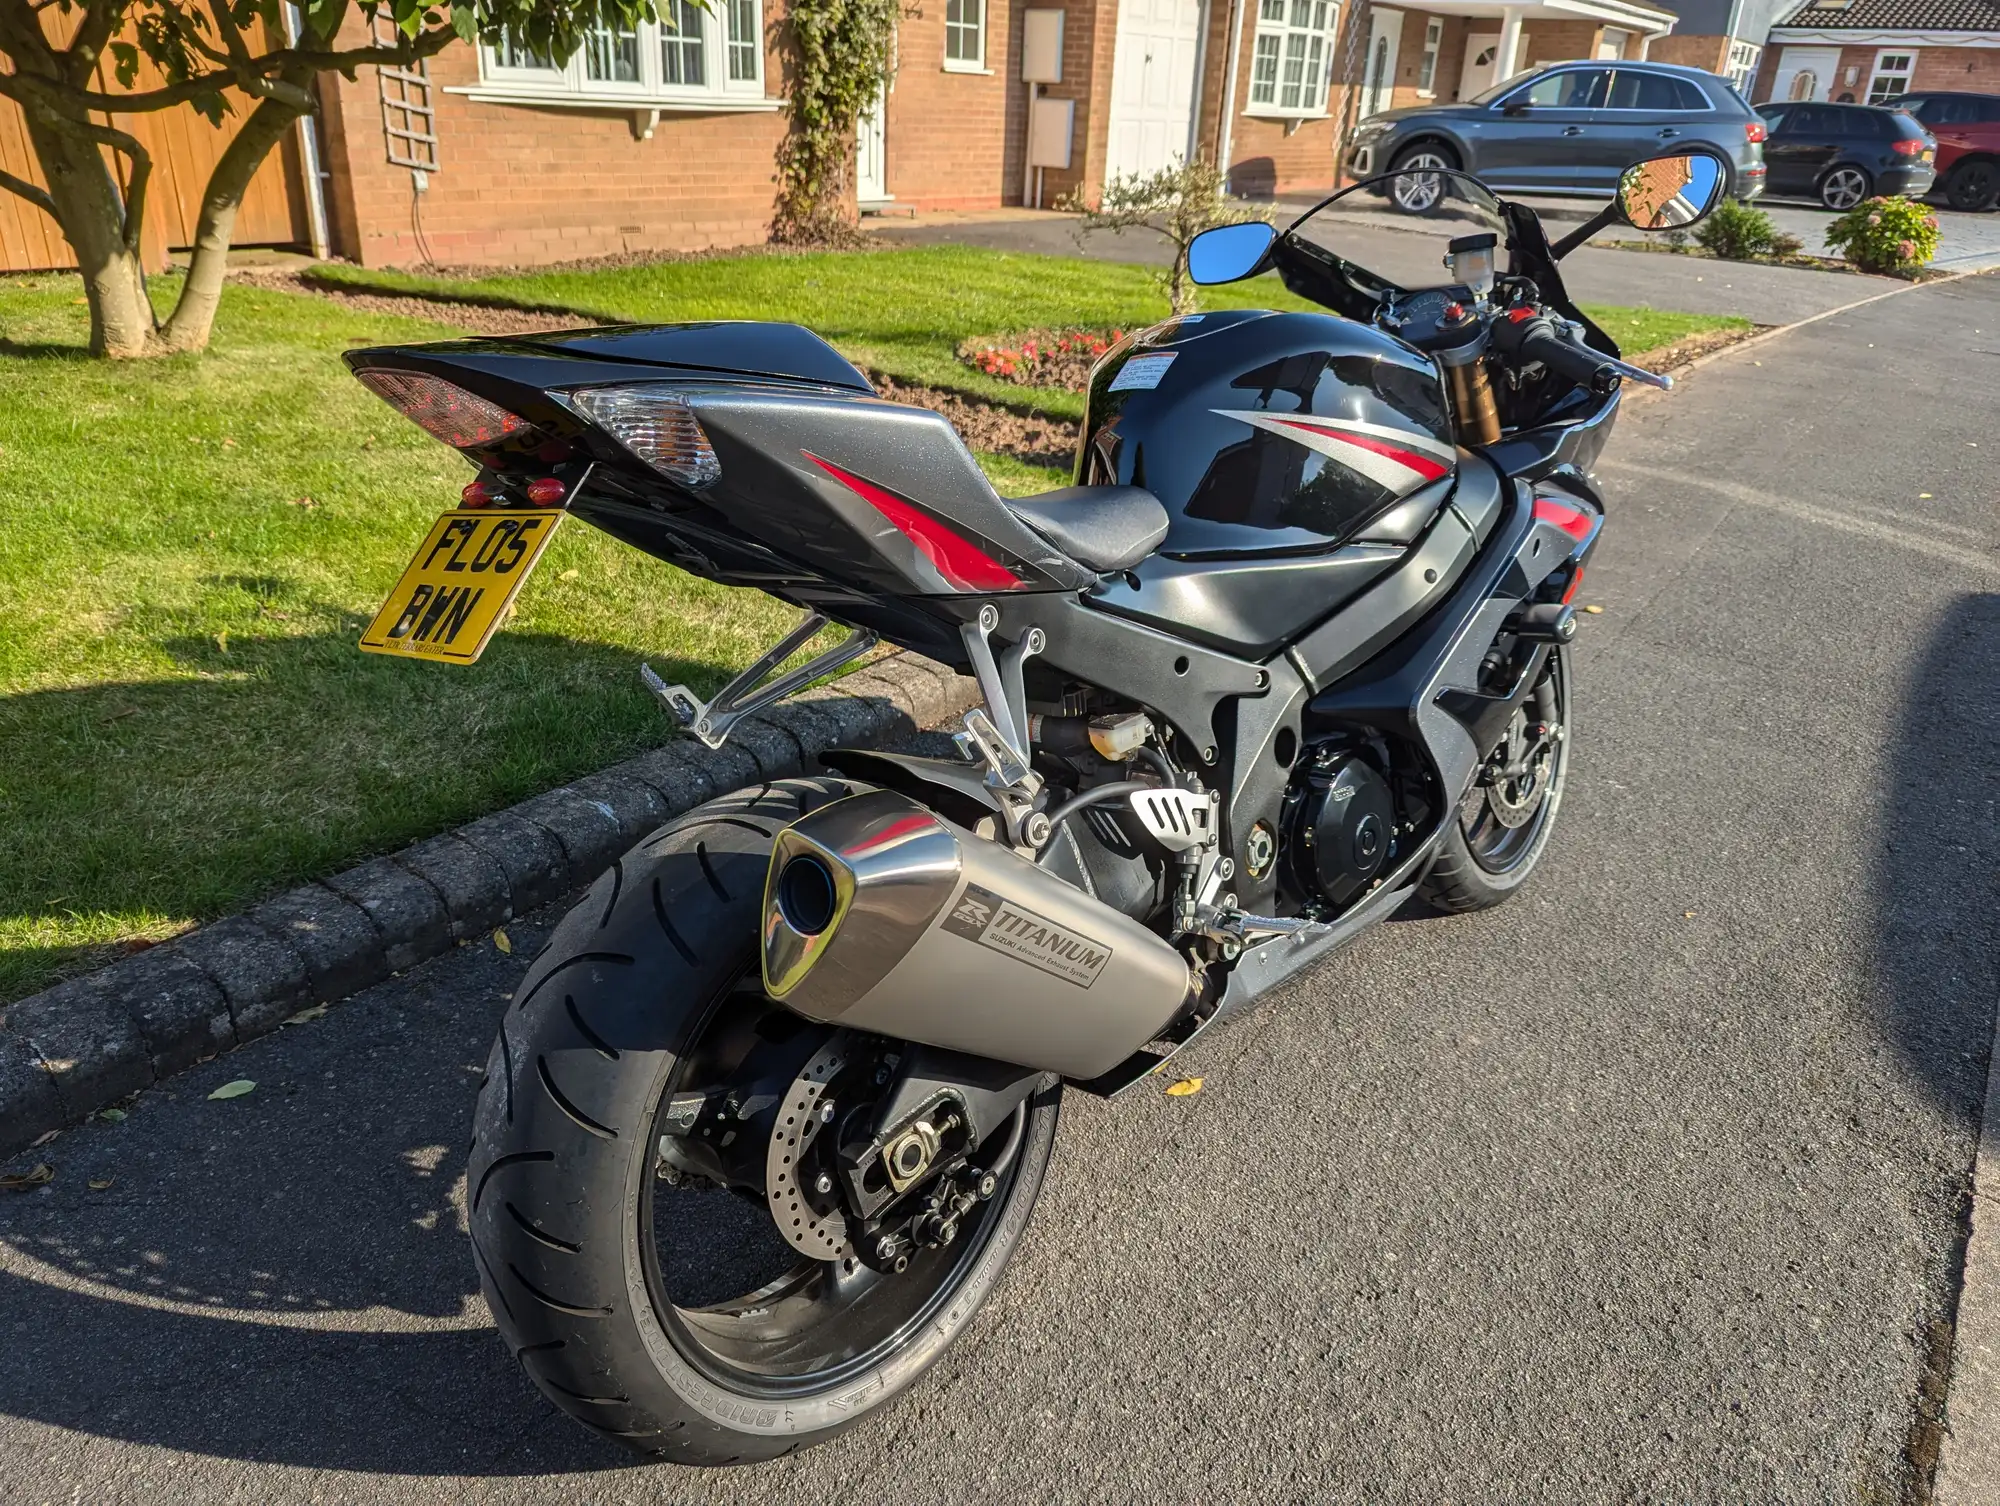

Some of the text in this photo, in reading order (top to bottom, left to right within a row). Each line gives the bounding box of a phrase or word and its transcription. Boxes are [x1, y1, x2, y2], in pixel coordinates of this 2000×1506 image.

[421, 519, 543, 574] FL05
[386, 584, 486, 645] BWN
[989, 932, 1090, 981] SUZUKI Advanced Exhaust System
[994, 910, 1105, 970] TITANIUM
